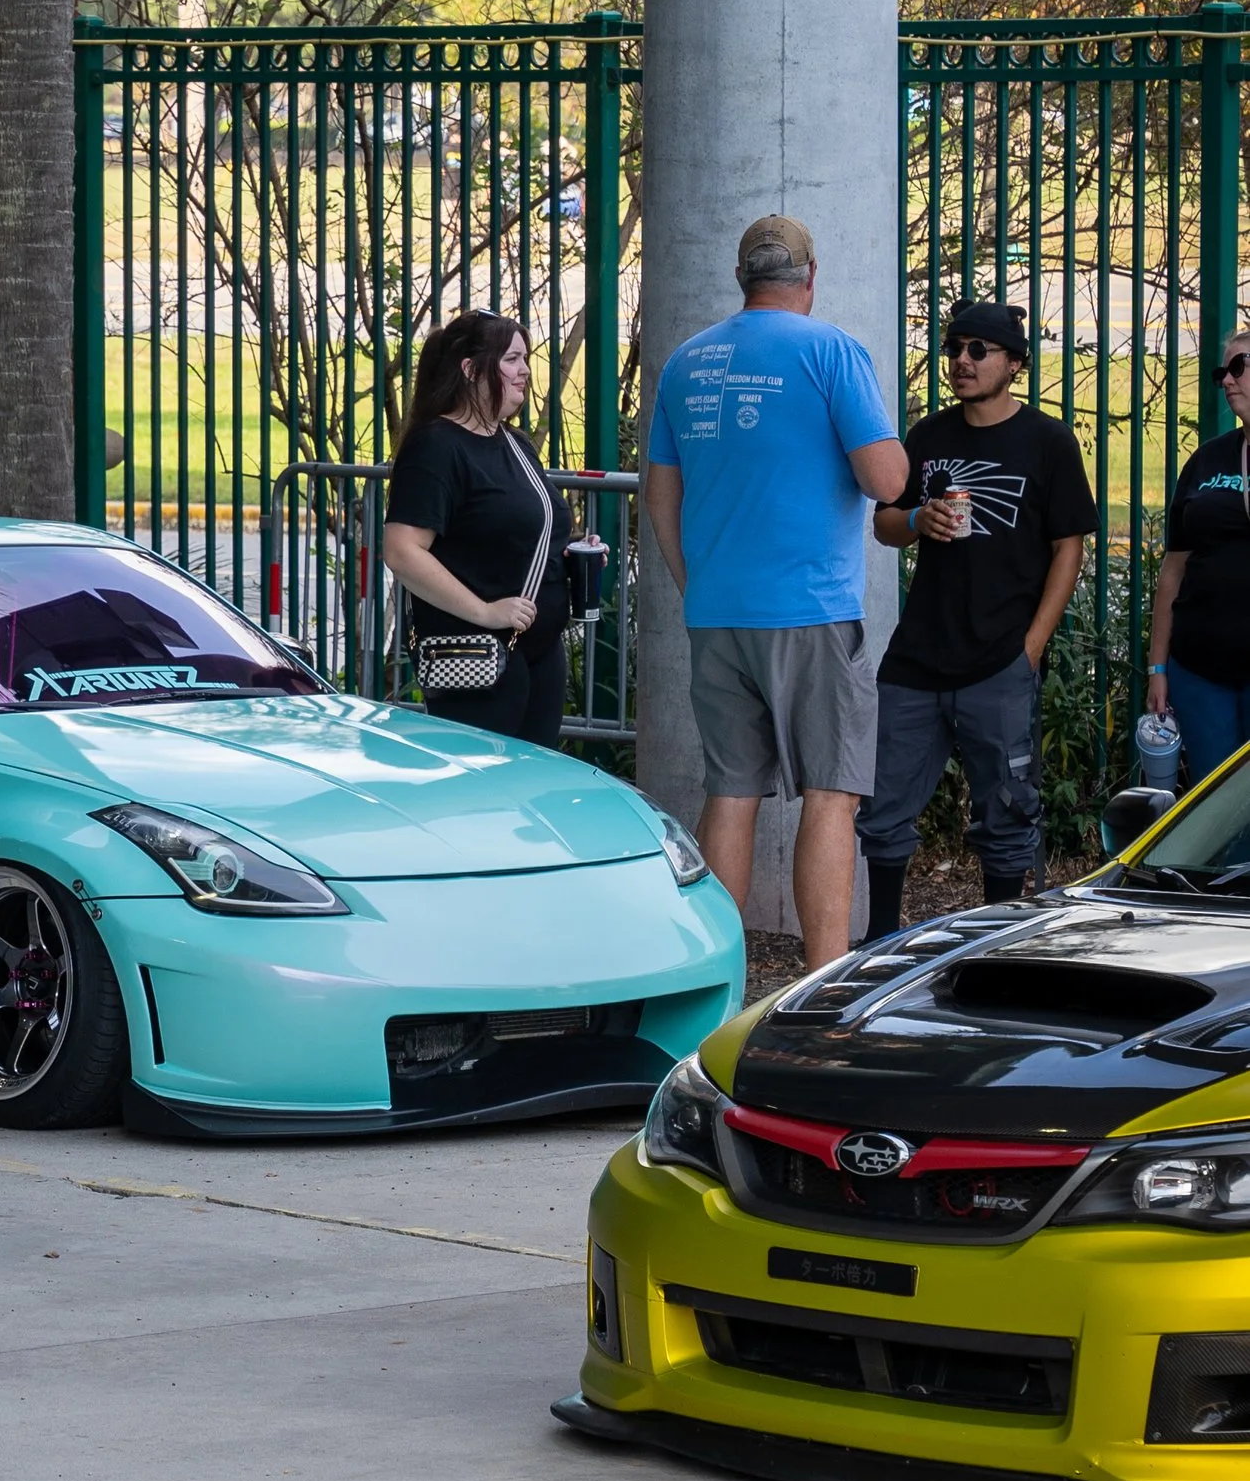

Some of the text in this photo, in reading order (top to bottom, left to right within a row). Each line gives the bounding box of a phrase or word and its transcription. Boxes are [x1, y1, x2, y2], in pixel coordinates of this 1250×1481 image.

[726, 375, 783, 386] FREEDOM BOAT CLUB
[738, 394, 762, 403] MEMBER
[972, 1194, 1031, 1212] WRX
